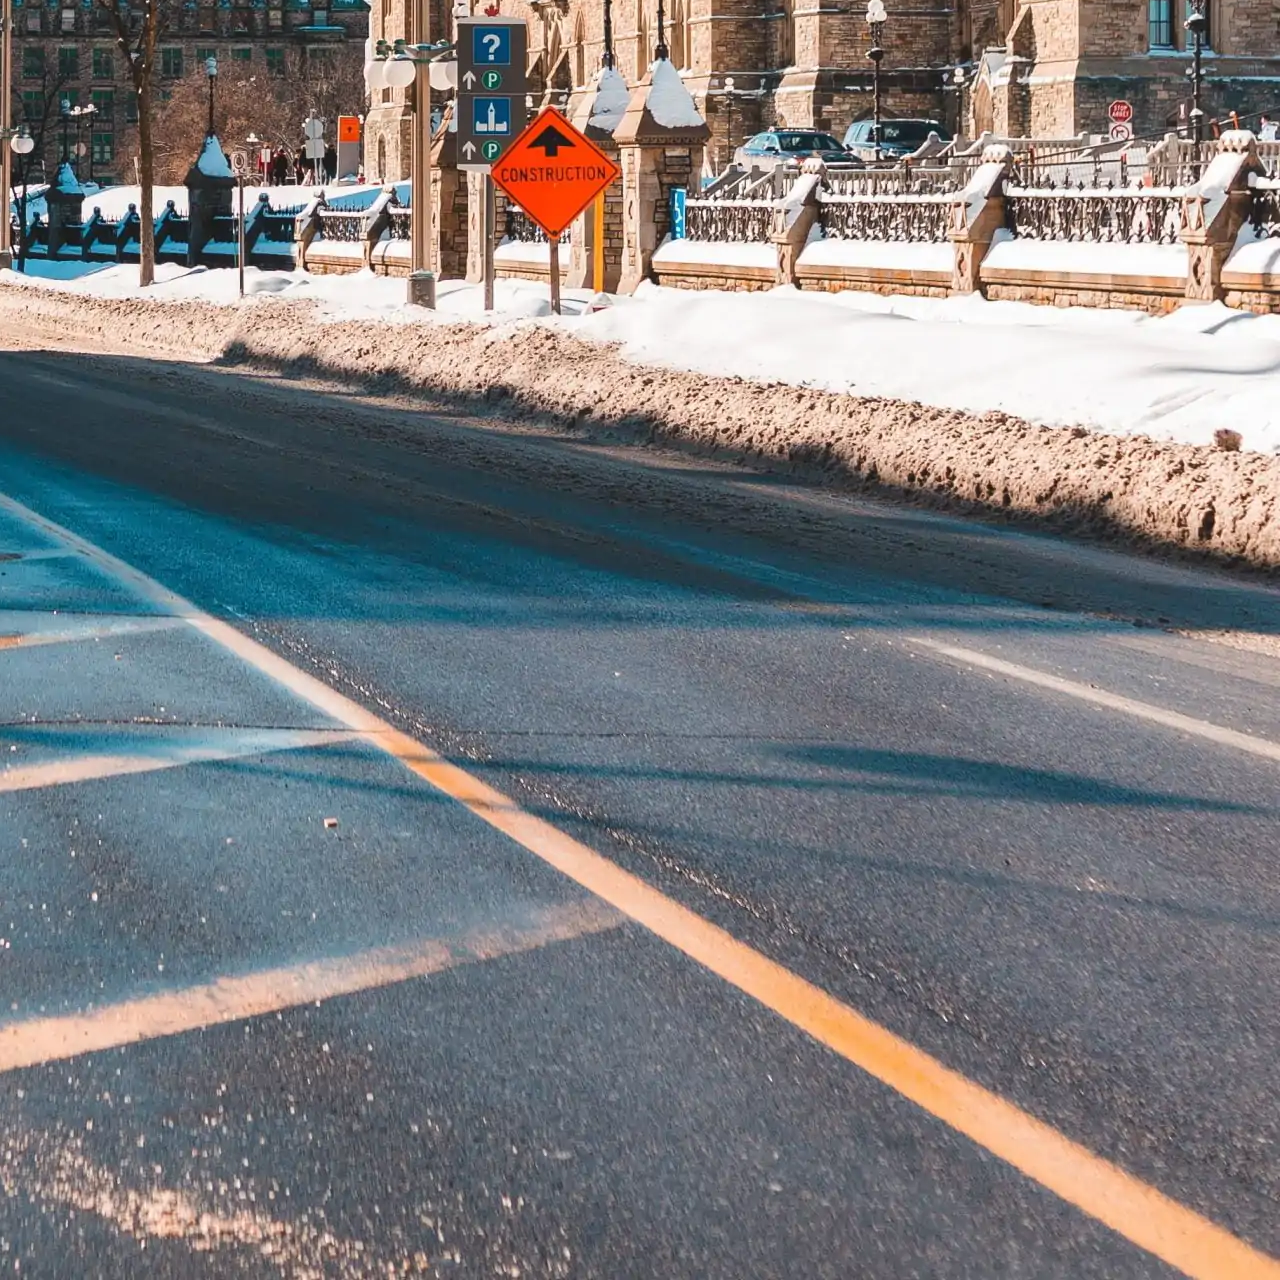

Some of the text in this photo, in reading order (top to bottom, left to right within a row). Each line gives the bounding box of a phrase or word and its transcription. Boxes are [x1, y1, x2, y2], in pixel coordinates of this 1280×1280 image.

[488, 73, 498, 88] P
[488, 143, 498, 158] P
[501, 166, 606, 183] CONSTRUCTION
